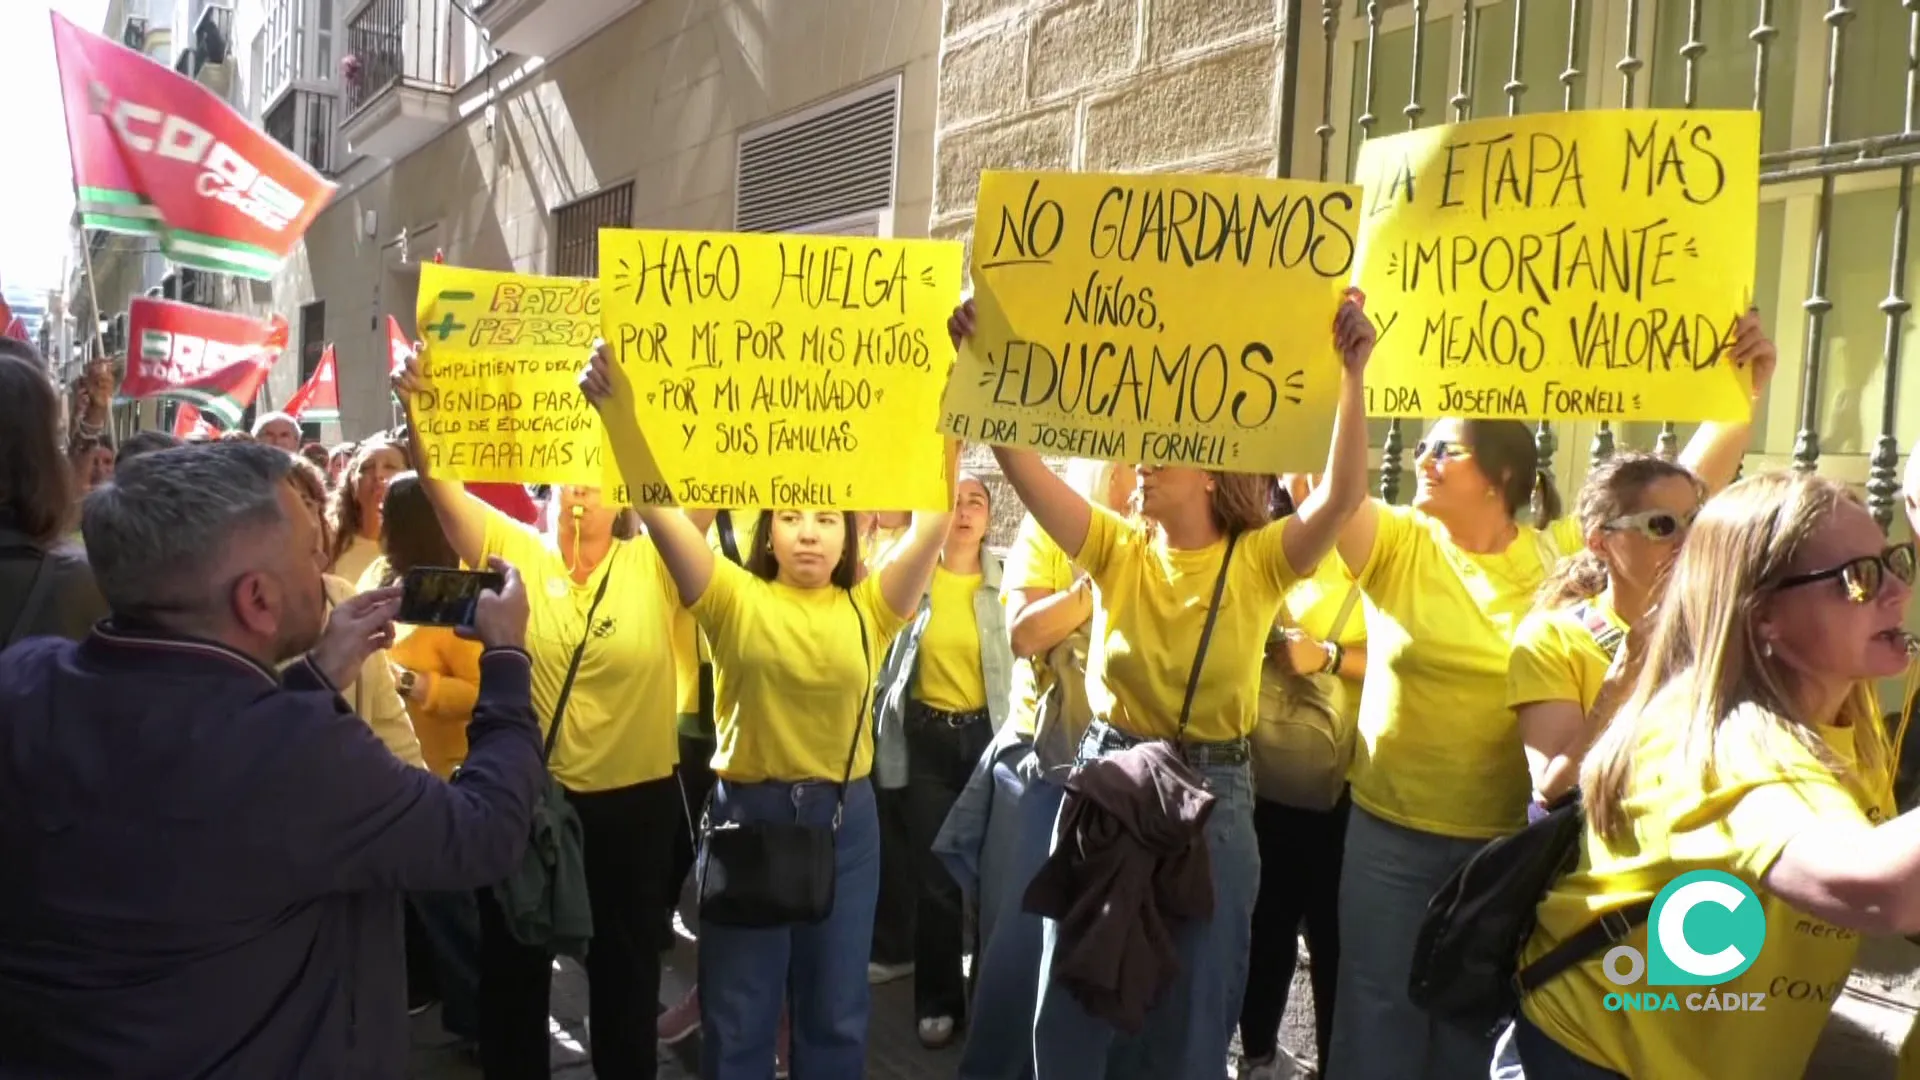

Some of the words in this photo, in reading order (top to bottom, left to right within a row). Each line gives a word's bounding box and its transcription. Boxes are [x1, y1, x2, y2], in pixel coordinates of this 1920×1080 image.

[1368, 151, 1417, 217] LA
[1439, 132, 1586, 220] ETAPA
[1621, 119, 1725, 205] MÁS
[990, 179, 1064, 262] NO
[1090, 185, 1355, 278] GUARDAMOS
[634, 238, 740, 307] HAGO
[772, 241, 908, 315] HUELGA
[1402, 218, 1678, 305] IMPORTANTE
[1064, 270, 1165, 333] NIÑOS,
[618, 321, 672, 367] POR
[734, 319, 785, 362] POR
[800, 324, 845, 366] MIS
[853, 322, 931, 373] HIJOS,
[1374, 311, 1398, 346] Y
[1419, 299, 1545, 373] MENOS
[1570, 301, 1740, 373] VALORADA
[423, 357, 540, 380] CUMPLIMIENTO
[659, 378, 698, 415] POR
[714, 375, 740, 412] MI
[751, 368, 871, 414] ALUMNADO
[993, 340, 1277, 429] EDUCAMOS
[418, 386, 522, 412] DIGNIDAD
[533, 390, 590, 411] PARA
[468, 418, 490, 432] DE
[497, 412, 592, 432] EDUCACIÓN
[1384, 386, 1422, 413] DRA
[1438, 382, 1528, 414] JOSEFINA
[1542, 382, 1625, 415] FORNELL
[449, 442, 523, 467] ETAPA
[530, 438, 574, 467] MÁS
[683, 423, 697, 452] Y
[715, 423, 758, 455] SUS
[768, 418, 858, 456] FAMILIAS
[980, 417, 1017, 443] DRA
[1029, 422, 1126, 457] JOSEFINA
[1141, 428, 1227, 465] FORNELL
[642, 482, 672, 504] DRA
[680, 475, 759, 505] JOSEFINA
[771, 474, 837, 506] FORNELL
